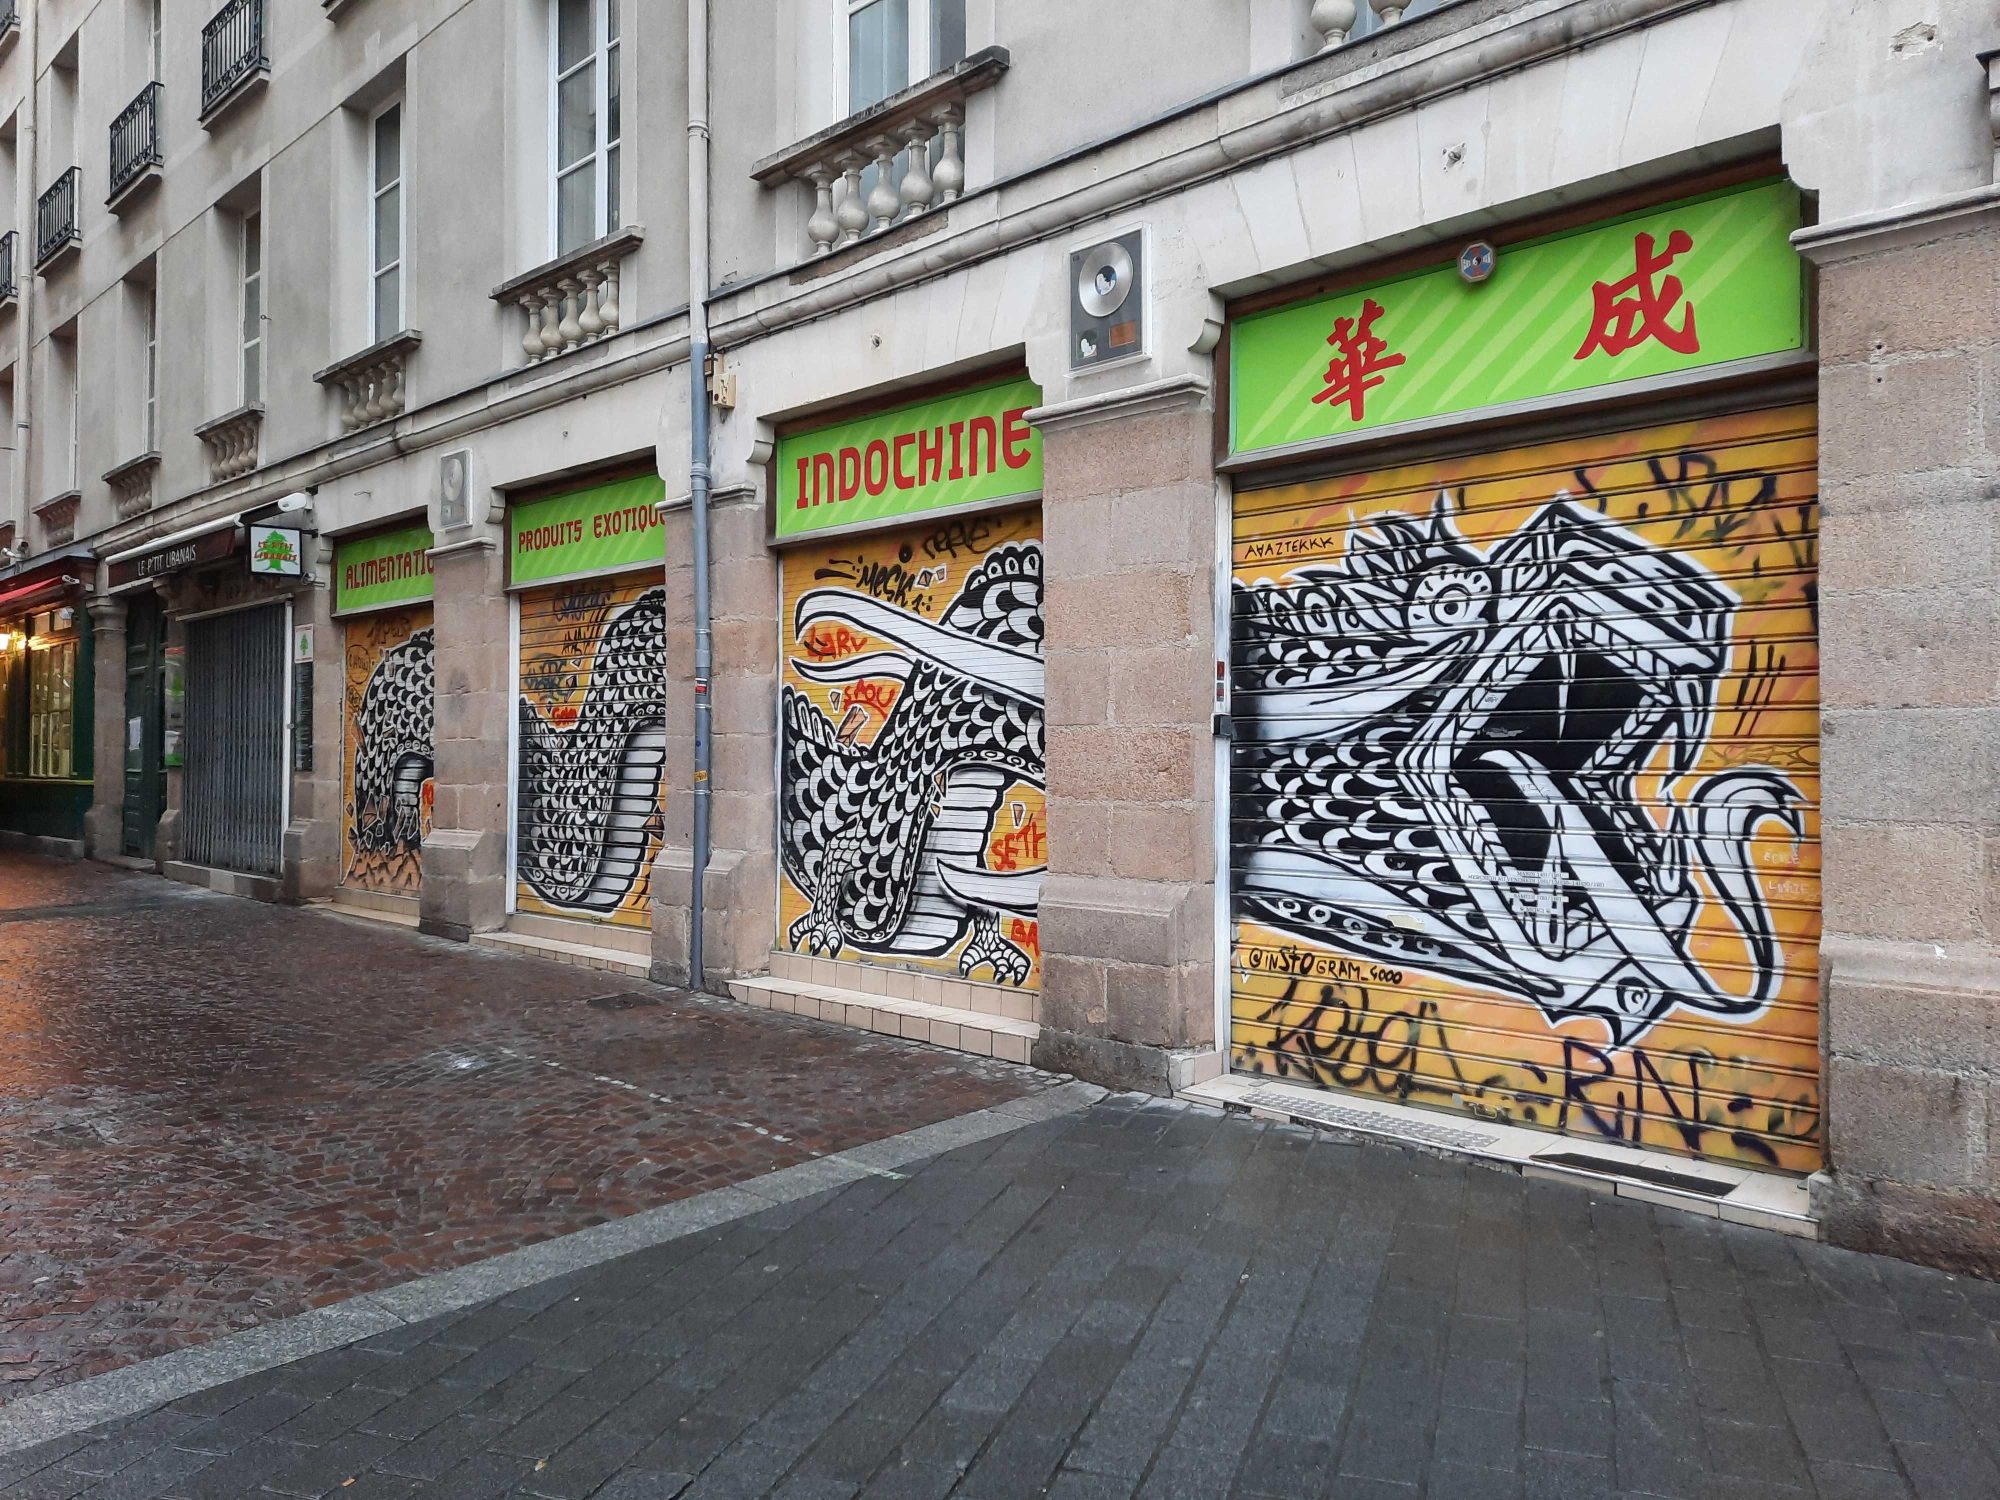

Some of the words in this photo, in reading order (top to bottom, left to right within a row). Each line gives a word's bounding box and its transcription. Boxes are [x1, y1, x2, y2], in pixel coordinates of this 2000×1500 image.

[1311, 298, 1406, 422] 華
[1572, 229, 1701, 360] 成
[796, 405, 1033, 510] INDOCHINE
[137, 560, 145, 577] LE
[147, 554, 164, 573] P'TIT
[165, 544, 196, 568] LIBANAIS
[518, 519, 583, 554] PRODUITS
